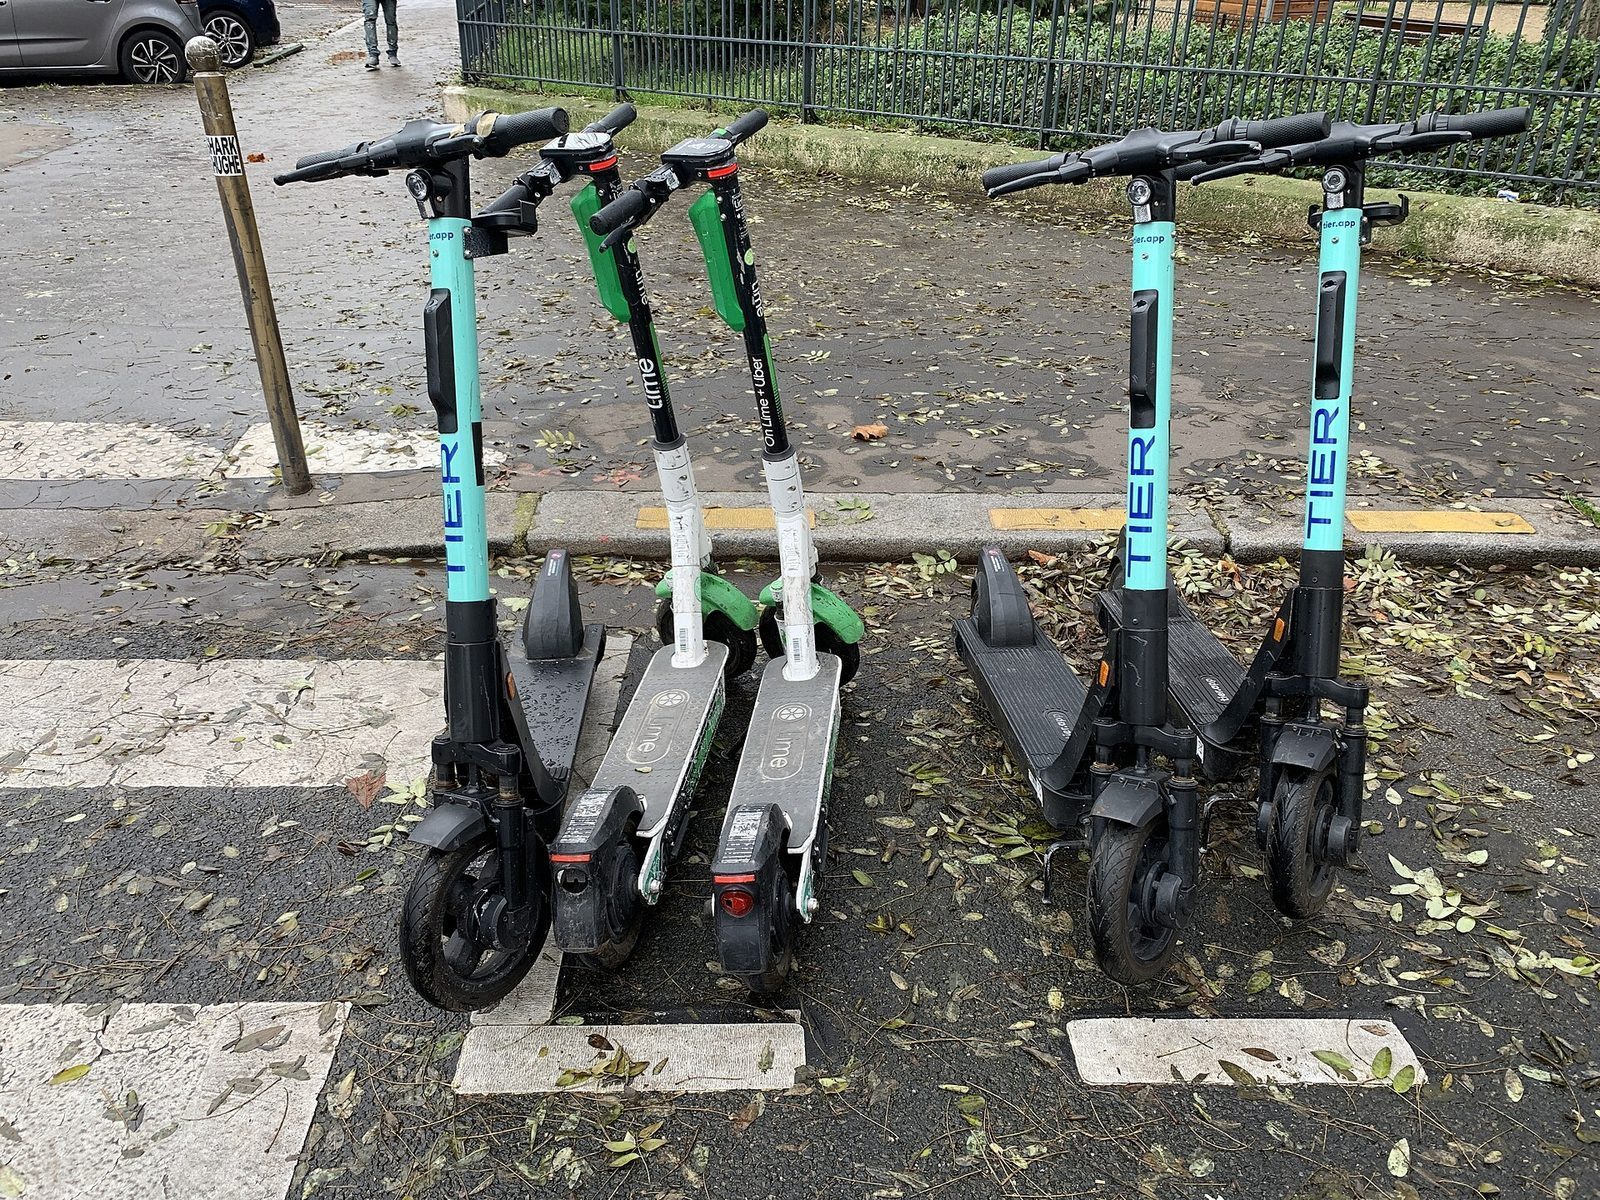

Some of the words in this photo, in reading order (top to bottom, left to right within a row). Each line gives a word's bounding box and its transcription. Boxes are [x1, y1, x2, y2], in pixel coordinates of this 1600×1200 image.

[1323, 220, 1356, 229] tier.app
[751, 281, 764, 318] Lime
[639, 358, 663, 409] Lime
[752, 356, 766, 387] Uber
[757, 388, 765, 397] +
[760, 398, 773, 427] Lime
[765, 428, 775, 447] On
[1306, 405, 1340, 539] TIER
[1127, 434, 1156, 578] TIER
